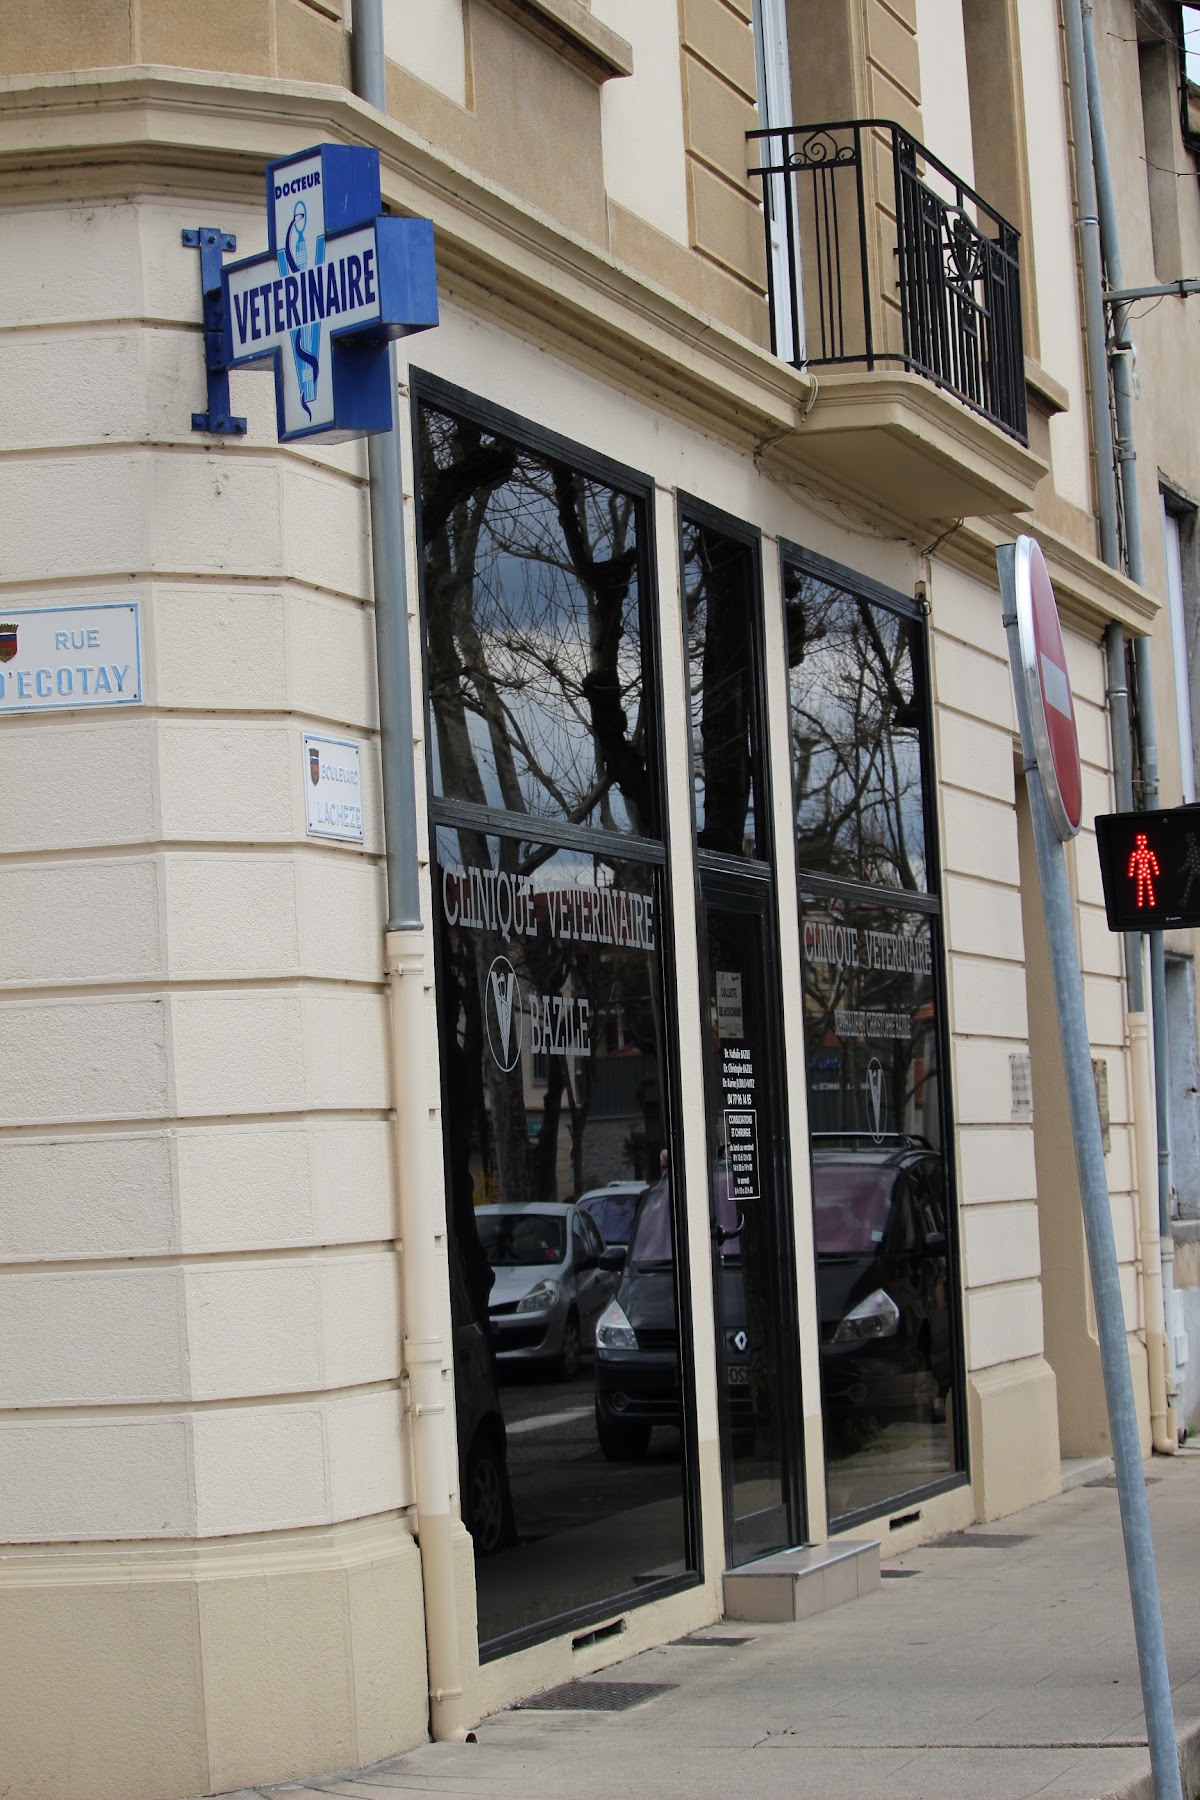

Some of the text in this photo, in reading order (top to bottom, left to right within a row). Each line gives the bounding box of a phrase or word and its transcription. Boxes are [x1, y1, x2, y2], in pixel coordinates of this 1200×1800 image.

[275, 171, 321, 200] DOCTEUR
[234, 249, 376, 344] VETERINAIRE
[55, 628, 100, 650] RUE
[321, 764, 359, 785] BOULEVARD
[317, 801, 362, 829] LACHEZE
[442, 864, 655, 951] CLINIQUE VETERINAIRE
[803, 921, 932, 976] CLINIQUE VETERINAIRE
[528, 994, 591, 1056] BAZILE
